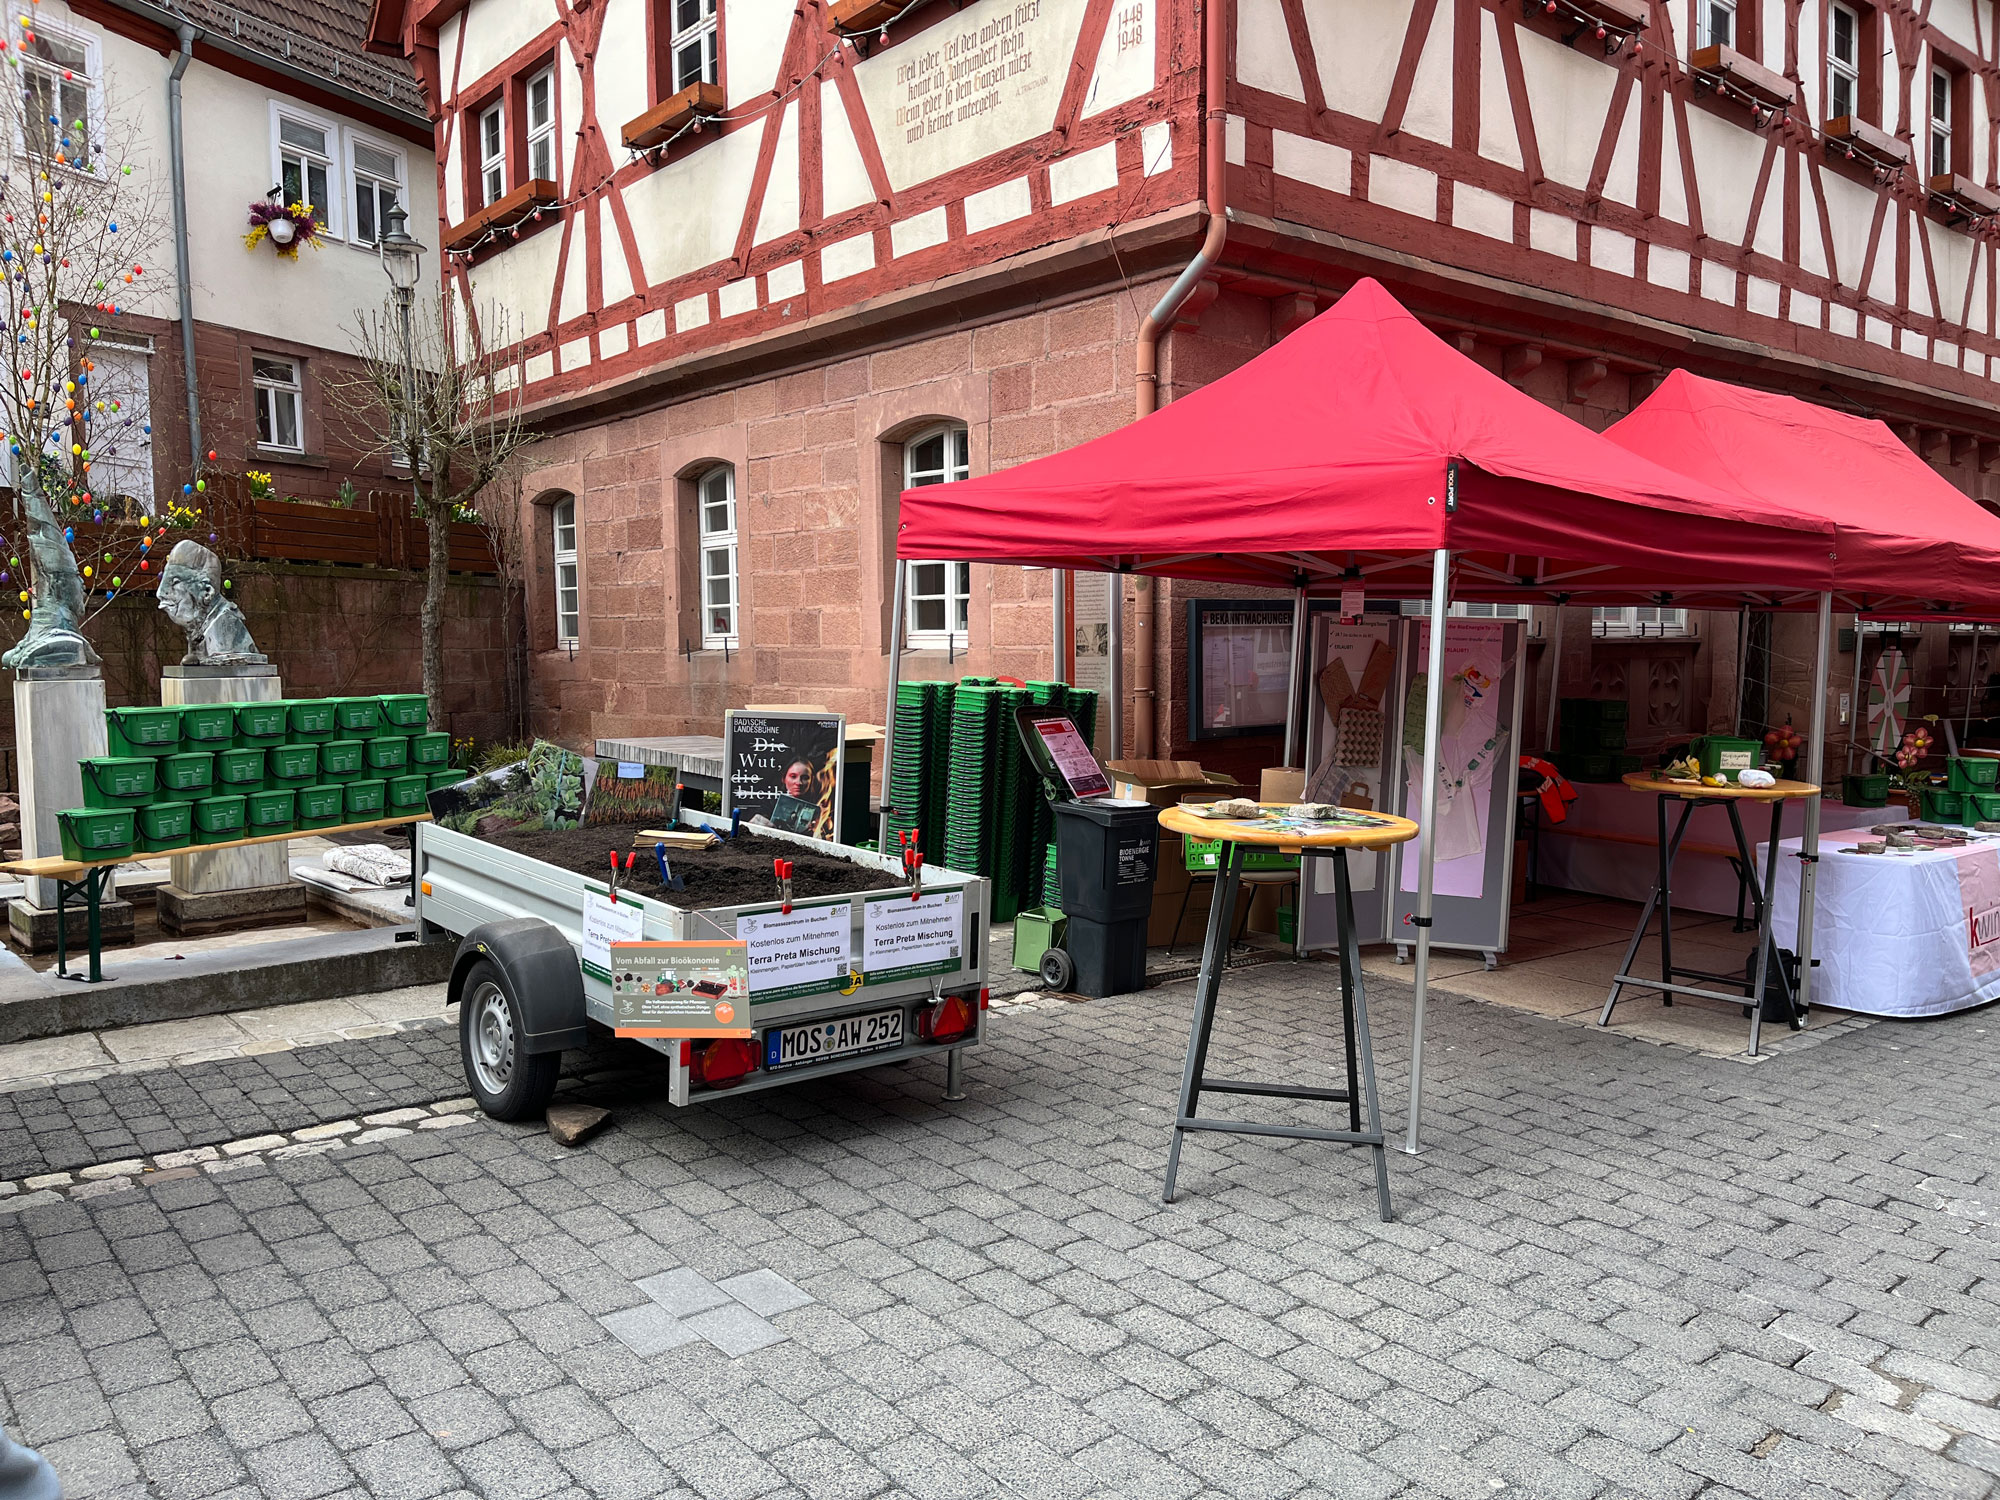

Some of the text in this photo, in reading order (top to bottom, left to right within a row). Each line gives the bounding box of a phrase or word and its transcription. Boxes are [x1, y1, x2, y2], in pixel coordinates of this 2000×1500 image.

[1118, 3, 1142, 31] 1448
[1117, 25, 1142, 56] 1948
[897, 59, 916, 85] Weil
[919, 50, 940, 77] jeder
[944, 34, 959, 62] Teil
[961, 31, 977, 54] den
[980, 14, 1012, 45] andern
[908, 77, 932, 102] konnt
[933, 67, 945, 90] ich
[946, 43, 998, 84] Jahrhundert
[896, 104, 920, 126] Wenn
[922, 93, 942, 118] jeder
[955, 80, 972, 102] dem
[974, 63, 1005, 92] Ganzen
[906, 90, 1002, 144] wird keiner untergehn.
[1210, 613, 1293, 625] BEKANNTMACHUNGEN
[734, 718, 767, 727] BADISCHE
[752, 737, 787, 752] Die
[739, 753, 782, 771] Wut,
[731, 769, 760, 783] die
[1119, 846, 1150, 855] BIOENERGIE
[945, 894, 959, 902] awn
[831, 906, 848, 915] awn
[876, 922, 905, 931] Kostenlos
[920, 915, 952, 925] Mitnehmen
[588, 928, 612, 945] Terra Preta
[750, 930, 840, 948] Kostenlos zum Mitnehmen
[874, 930, 953, 947] Terra Preta Mischung
[634, 956, 656, 964] Abfall
[670, 956, 720, 964] Bioökonomie
[749, 946, 841, 965] Terra Preta Mischung
[782, 1013, 901, 1058] MOS AW 252
[771, 1051, 777, 1059] D
